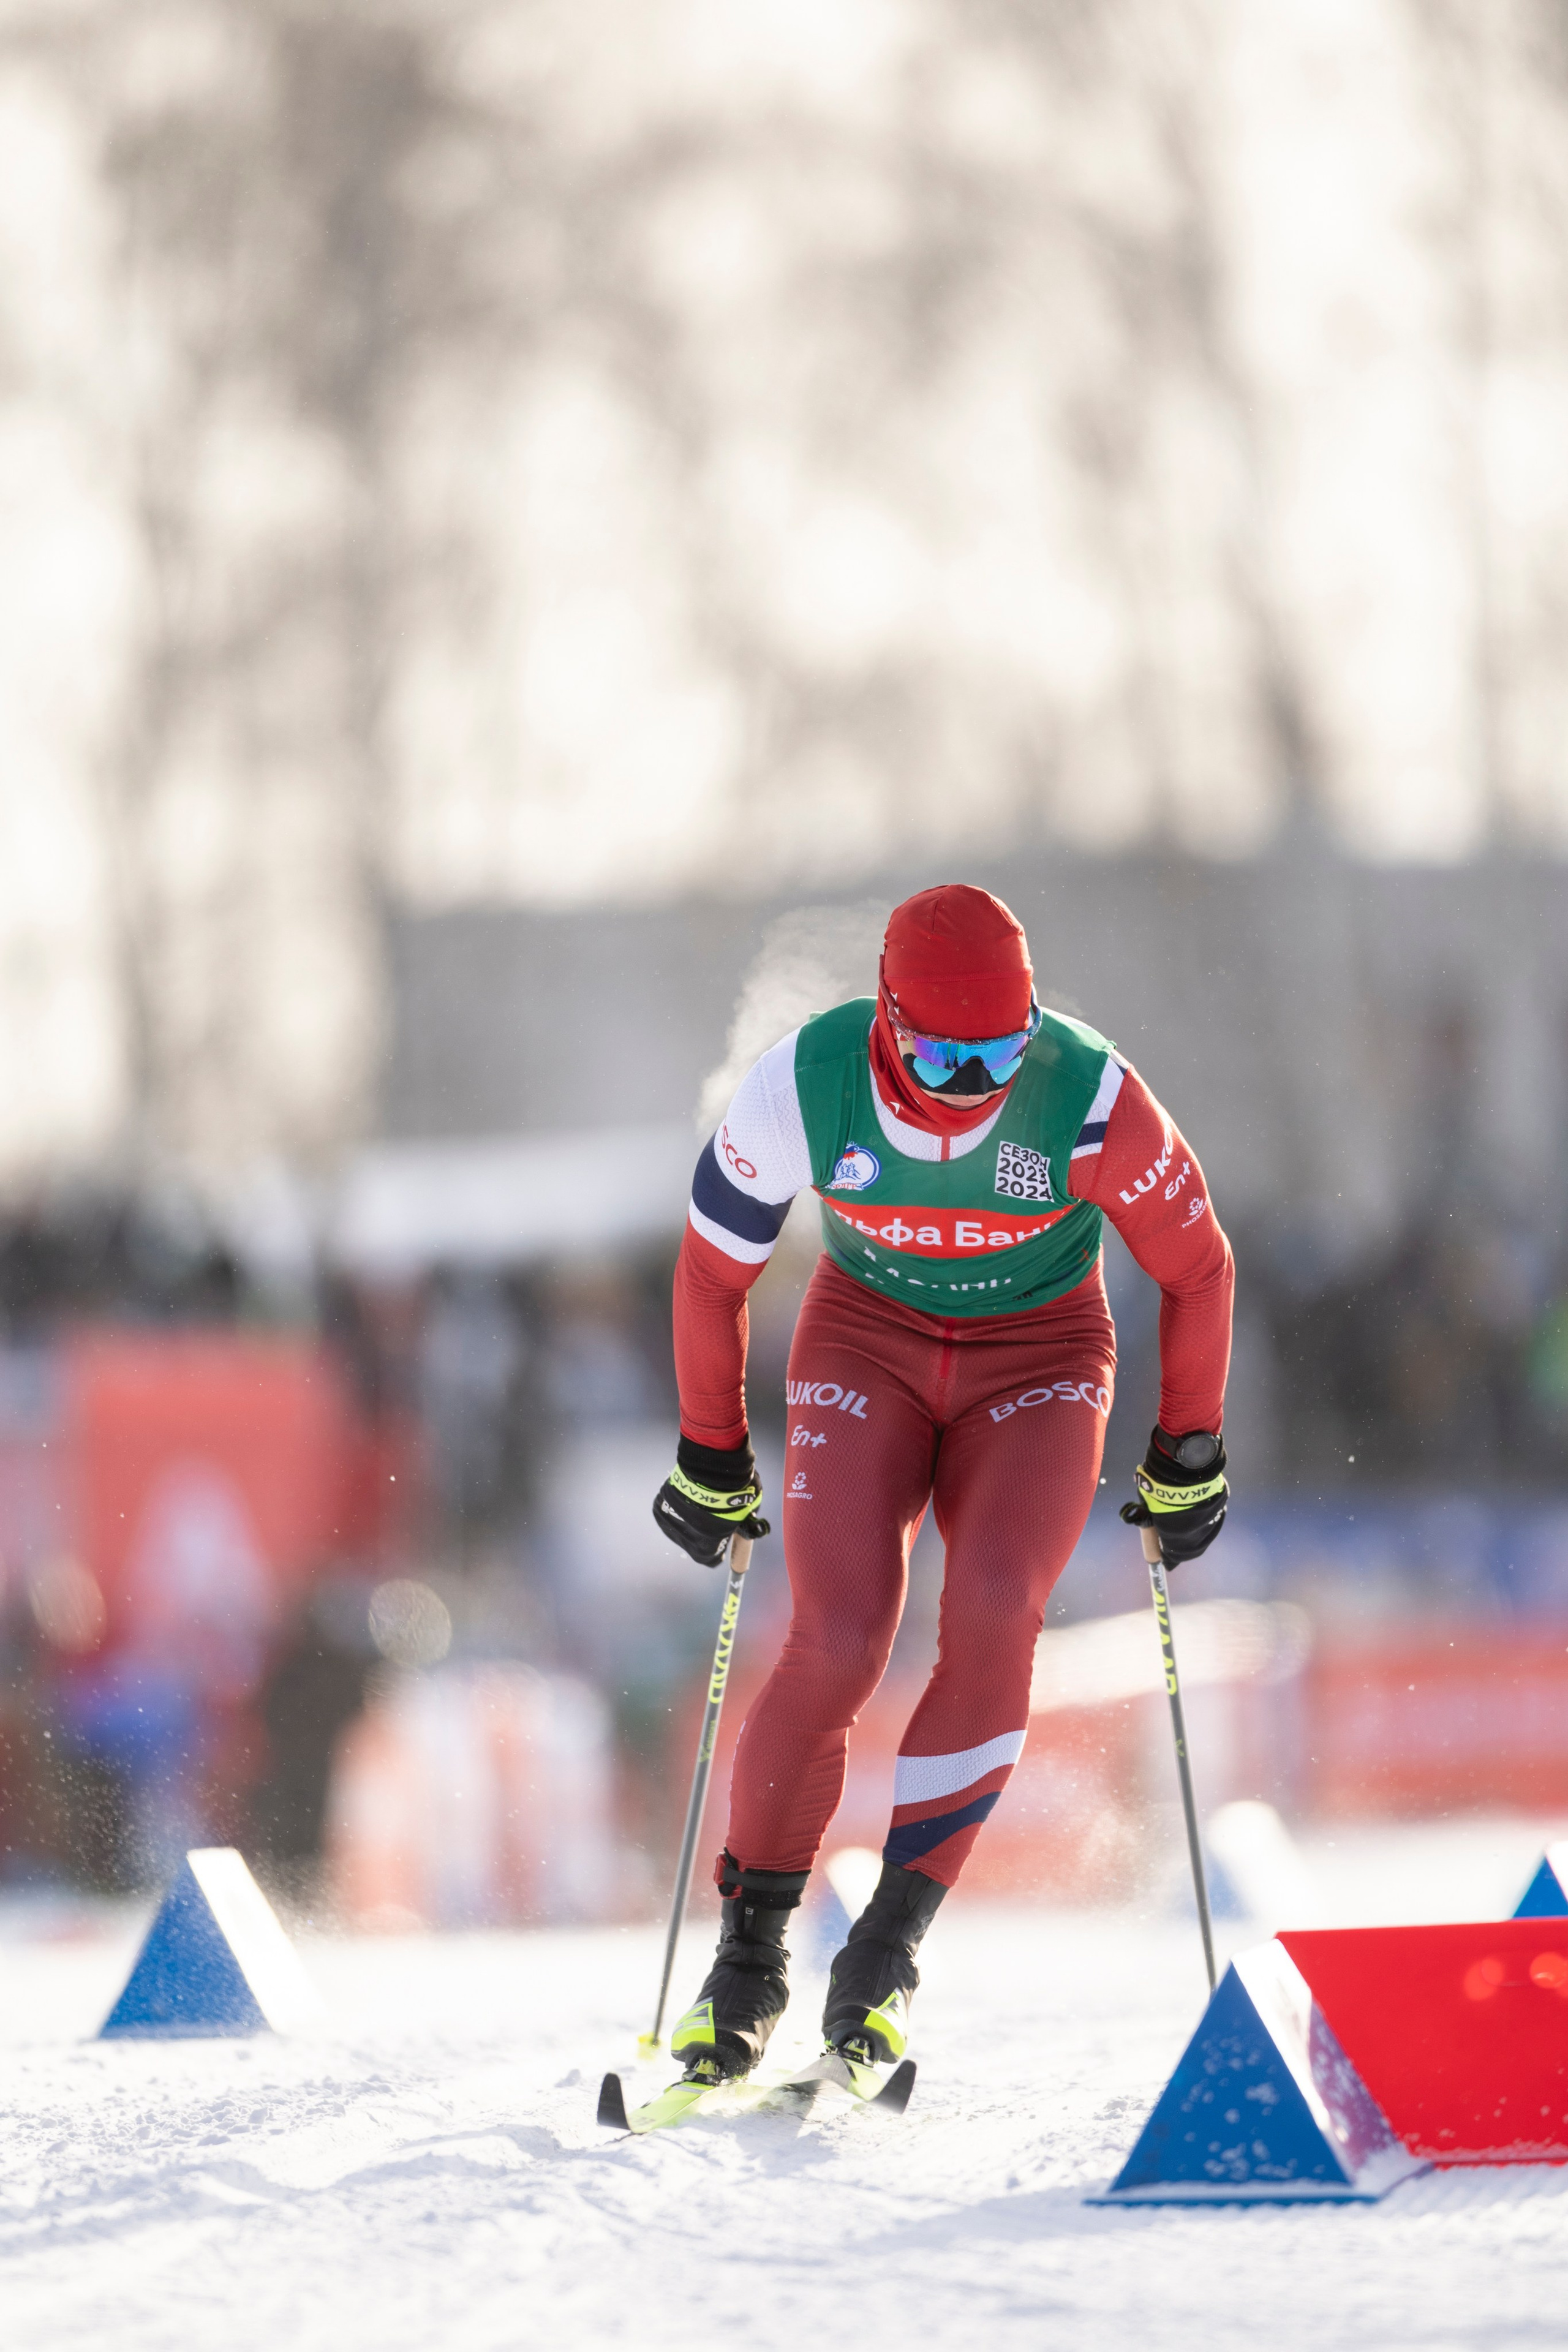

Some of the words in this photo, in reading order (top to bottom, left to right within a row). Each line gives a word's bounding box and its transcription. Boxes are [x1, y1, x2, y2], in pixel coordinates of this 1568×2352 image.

[722, 1124, 757, 1178] SCO
[1000, 1143, 1047, 1170] СЕЗОН
[1118, 1126, 1173, 1205] LUKO
[996, 1177, 1052, 1200] 2024
[998, 1157, 1047, 1185] 2023
[834, 1209, 943, 1246] льфа
[989, 1381, 1111, 1423] BOSCO
